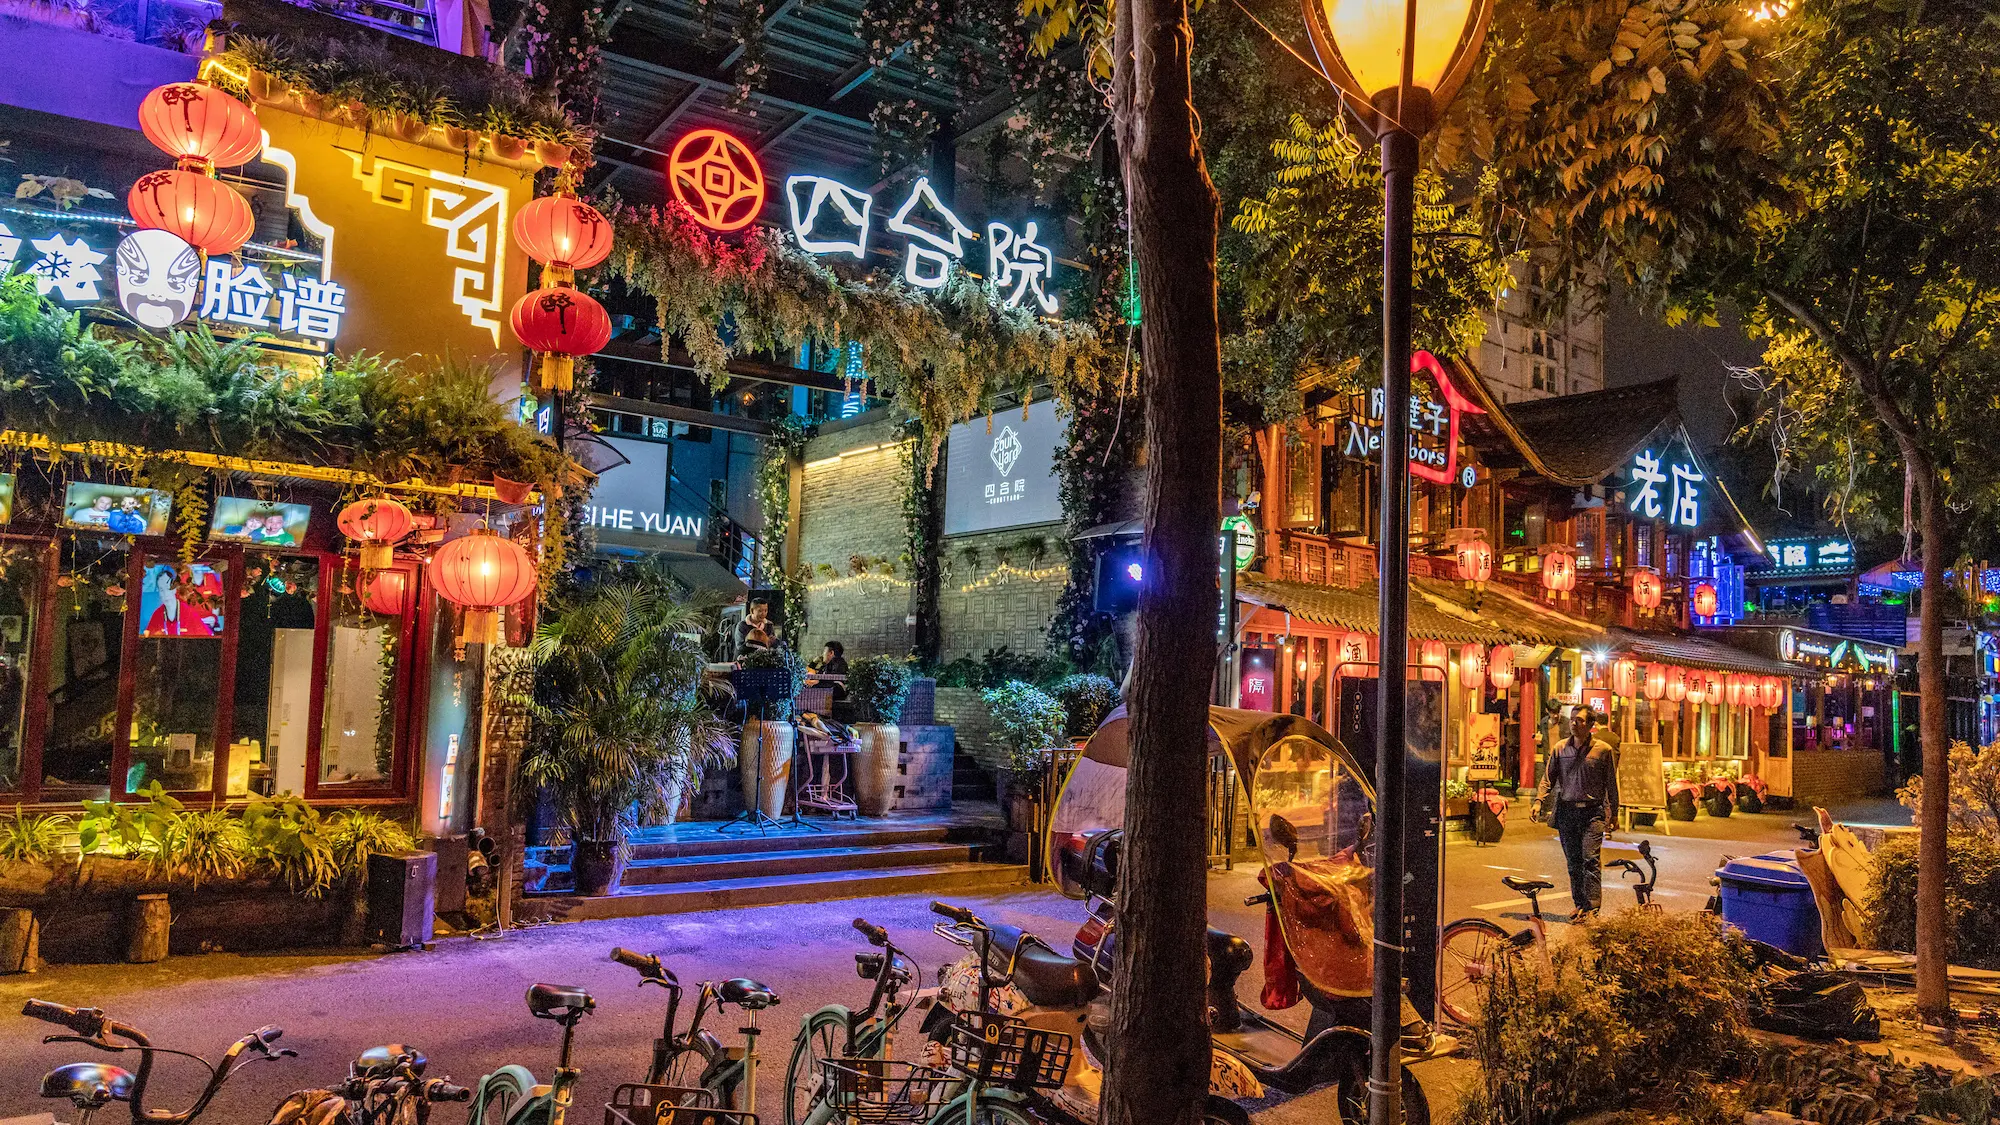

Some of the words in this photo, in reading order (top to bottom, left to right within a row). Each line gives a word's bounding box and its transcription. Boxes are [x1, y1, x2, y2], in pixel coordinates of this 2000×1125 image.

[786, 175, 1059, 314] 四合院
[0, 222, 108, 300] 花
[200, 259, 346, 340] 脸谱
[985, 479, 1025, 498] 四合院
[1630, 449, 1704, 527] 老店
[601, 507, 634, 530] HE
[639, 511, 702, 537] YUAN
[1346, 641, 1362, 662] 酒
[1248, 678, 1265, 694] 隔
